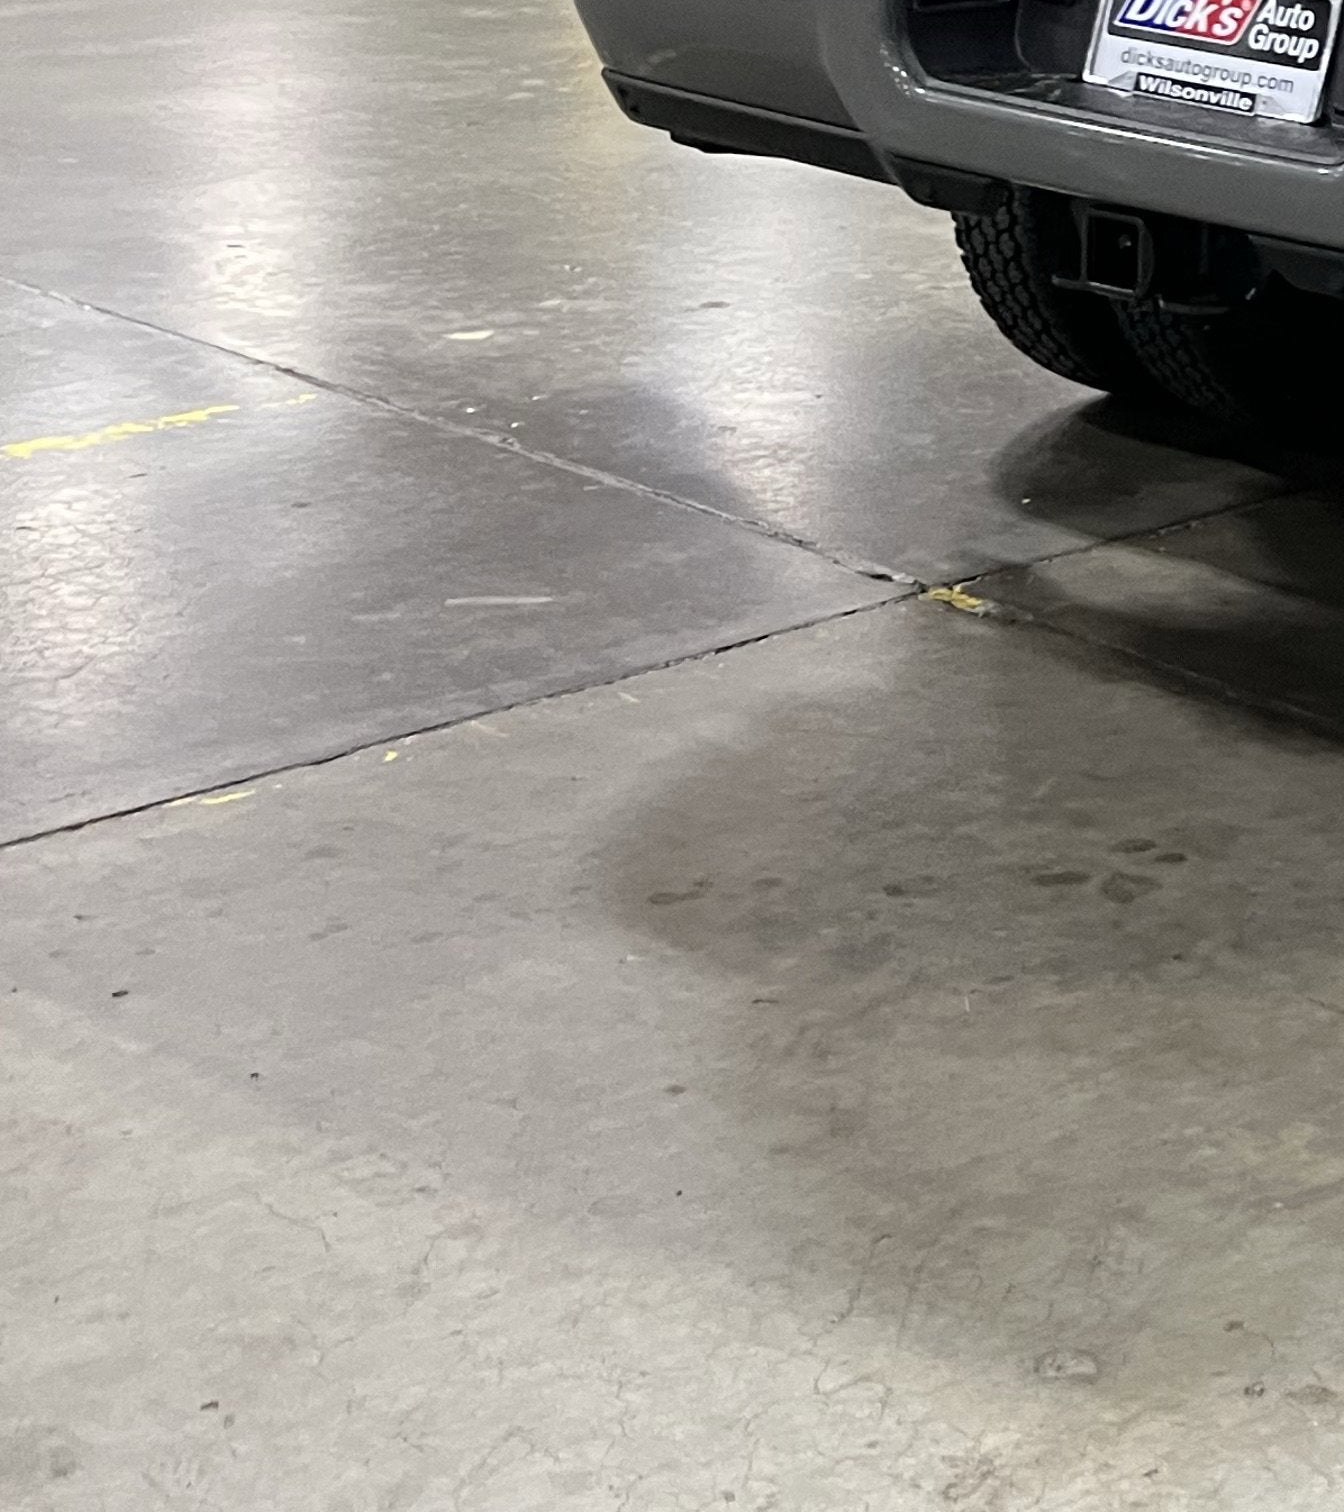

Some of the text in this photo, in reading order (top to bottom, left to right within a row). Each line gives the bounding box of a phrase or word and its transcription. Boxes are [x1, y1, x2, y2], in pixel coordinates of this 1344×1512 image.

[1247, 23, 1320, 65] Group
[1119, 46, 1295, 94] dicksautogroup.com
[1137, 73, 1254, 112] Wilsonville
